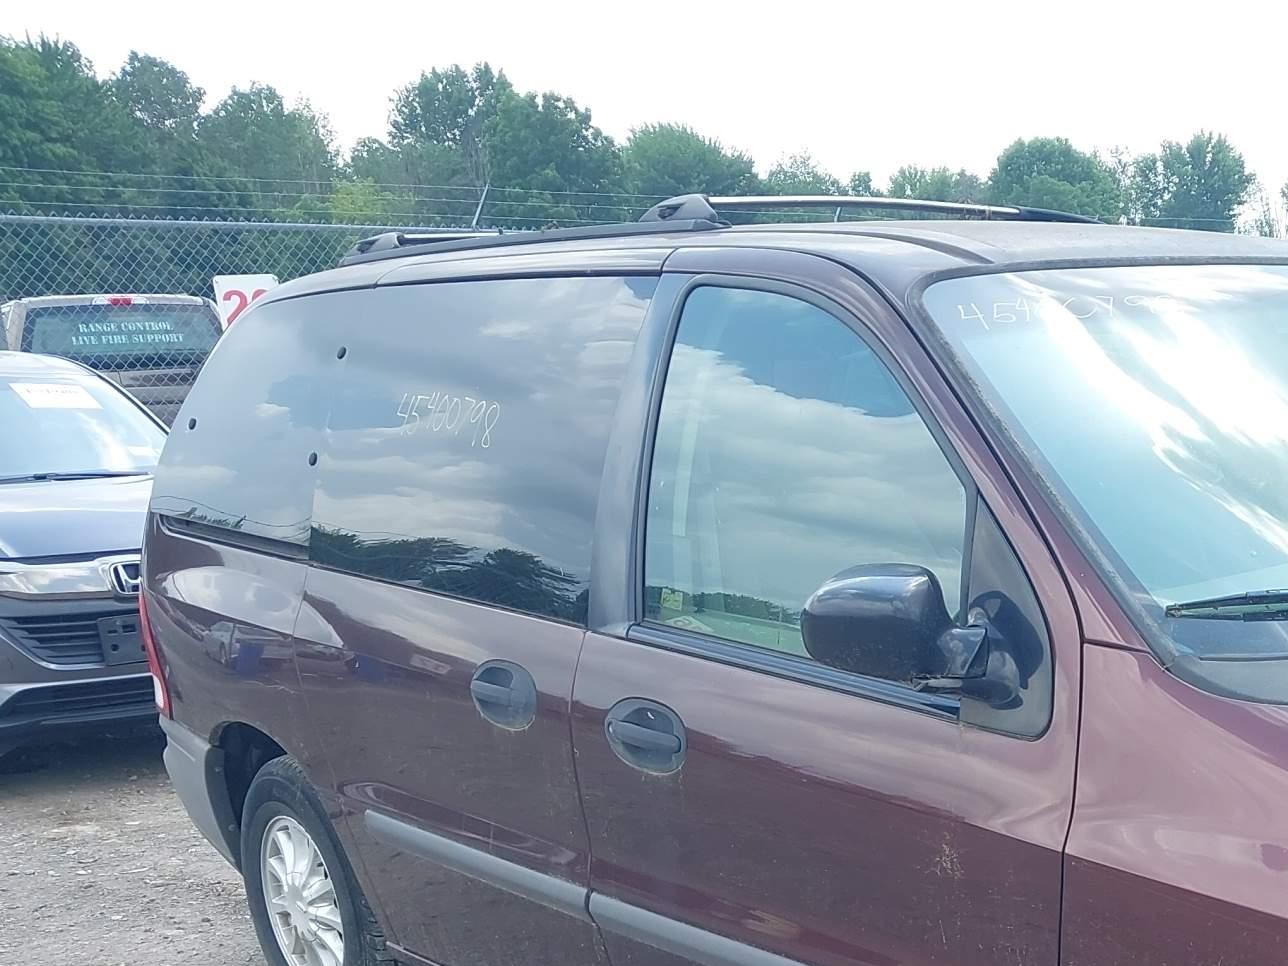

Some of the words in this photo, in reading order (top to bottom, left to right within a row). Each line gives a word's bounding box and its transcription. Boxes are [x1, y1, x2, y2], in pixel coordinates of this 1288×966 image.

[222, 289, 269, 326] 2
[71, 335, 99, 346] LIVE
[101, 334, 130, 345] FIRE
[132, 332, 184, 344] SUPPORT
[78, 321, 118, 333] RANGE
[120, 321, 174, 332] CONTROL
[397, 392, 500, 448] 45400798
